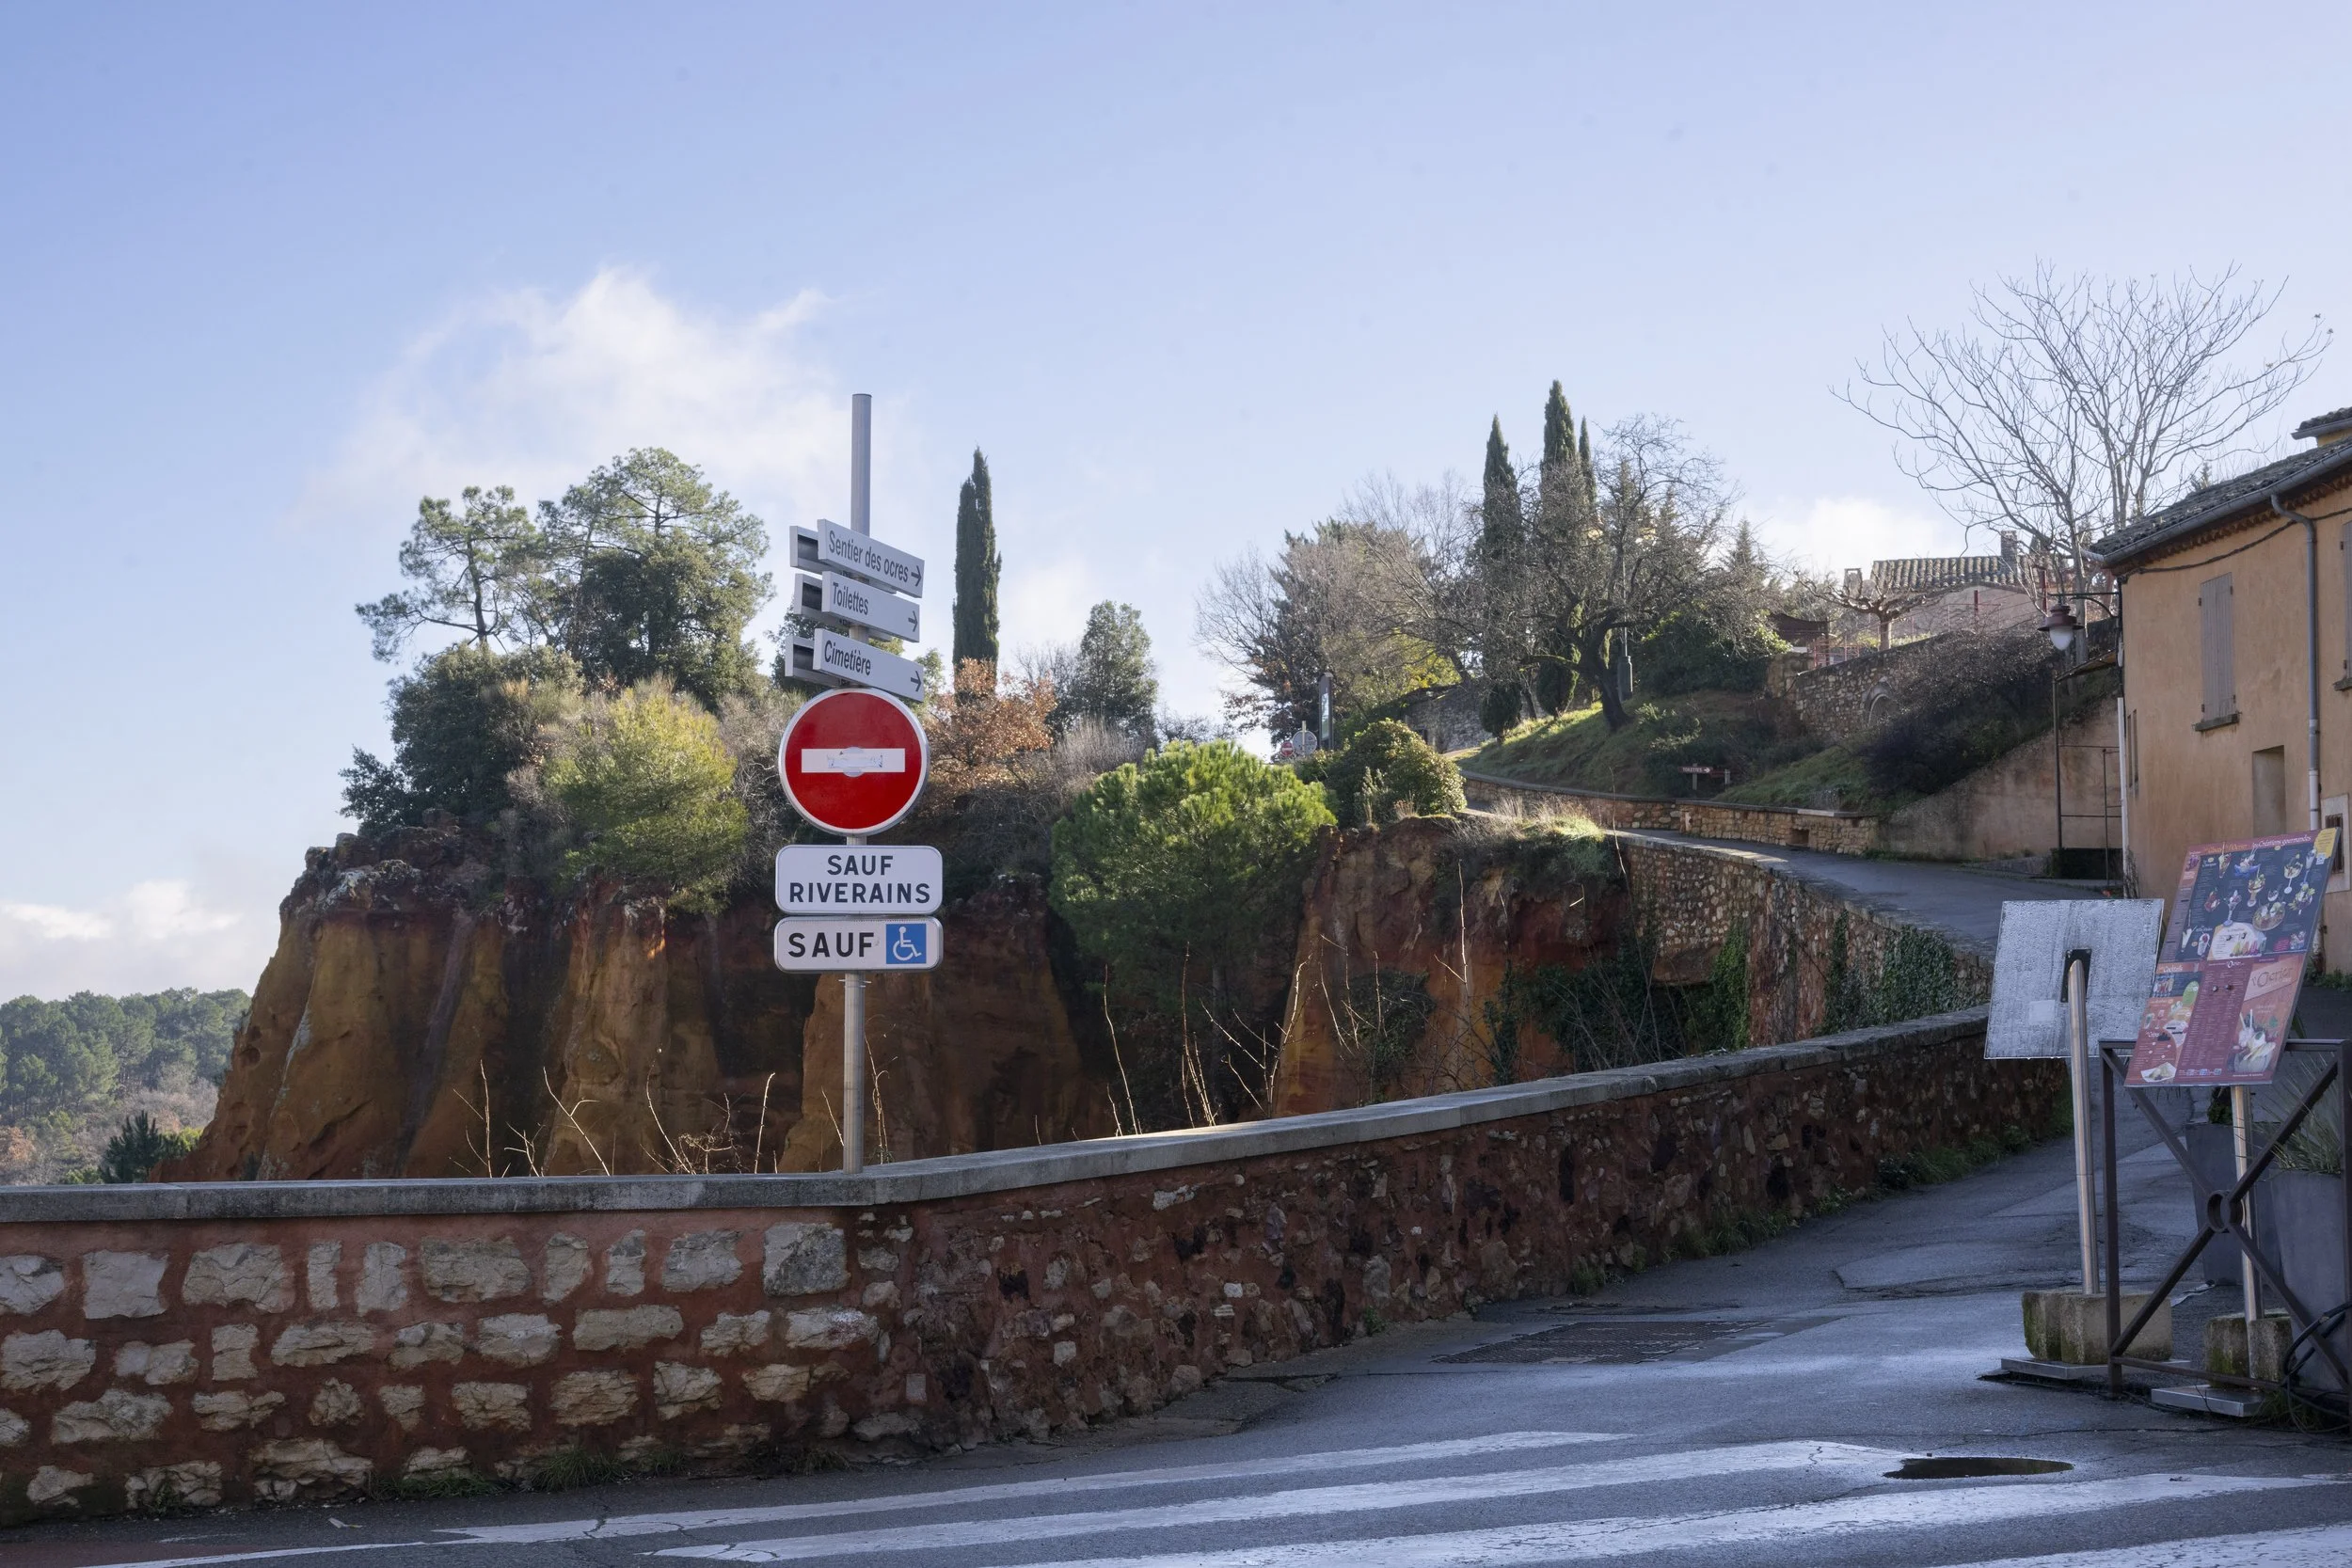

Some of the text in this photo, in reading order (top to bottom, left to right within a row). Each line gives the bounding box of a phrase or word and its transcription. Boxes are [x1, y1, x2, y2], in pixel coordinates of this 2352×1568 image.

[828, 530, 909, 583] Sentier des ocres
[833, 581, 868, 616] Toilettes
[824, 640, 871, 676] Cimetière
[827, 854, 893, 876] SAUF
[789, 882, 930, 904] RIVERAINS
[787, 932, 875, 958] SAUF
